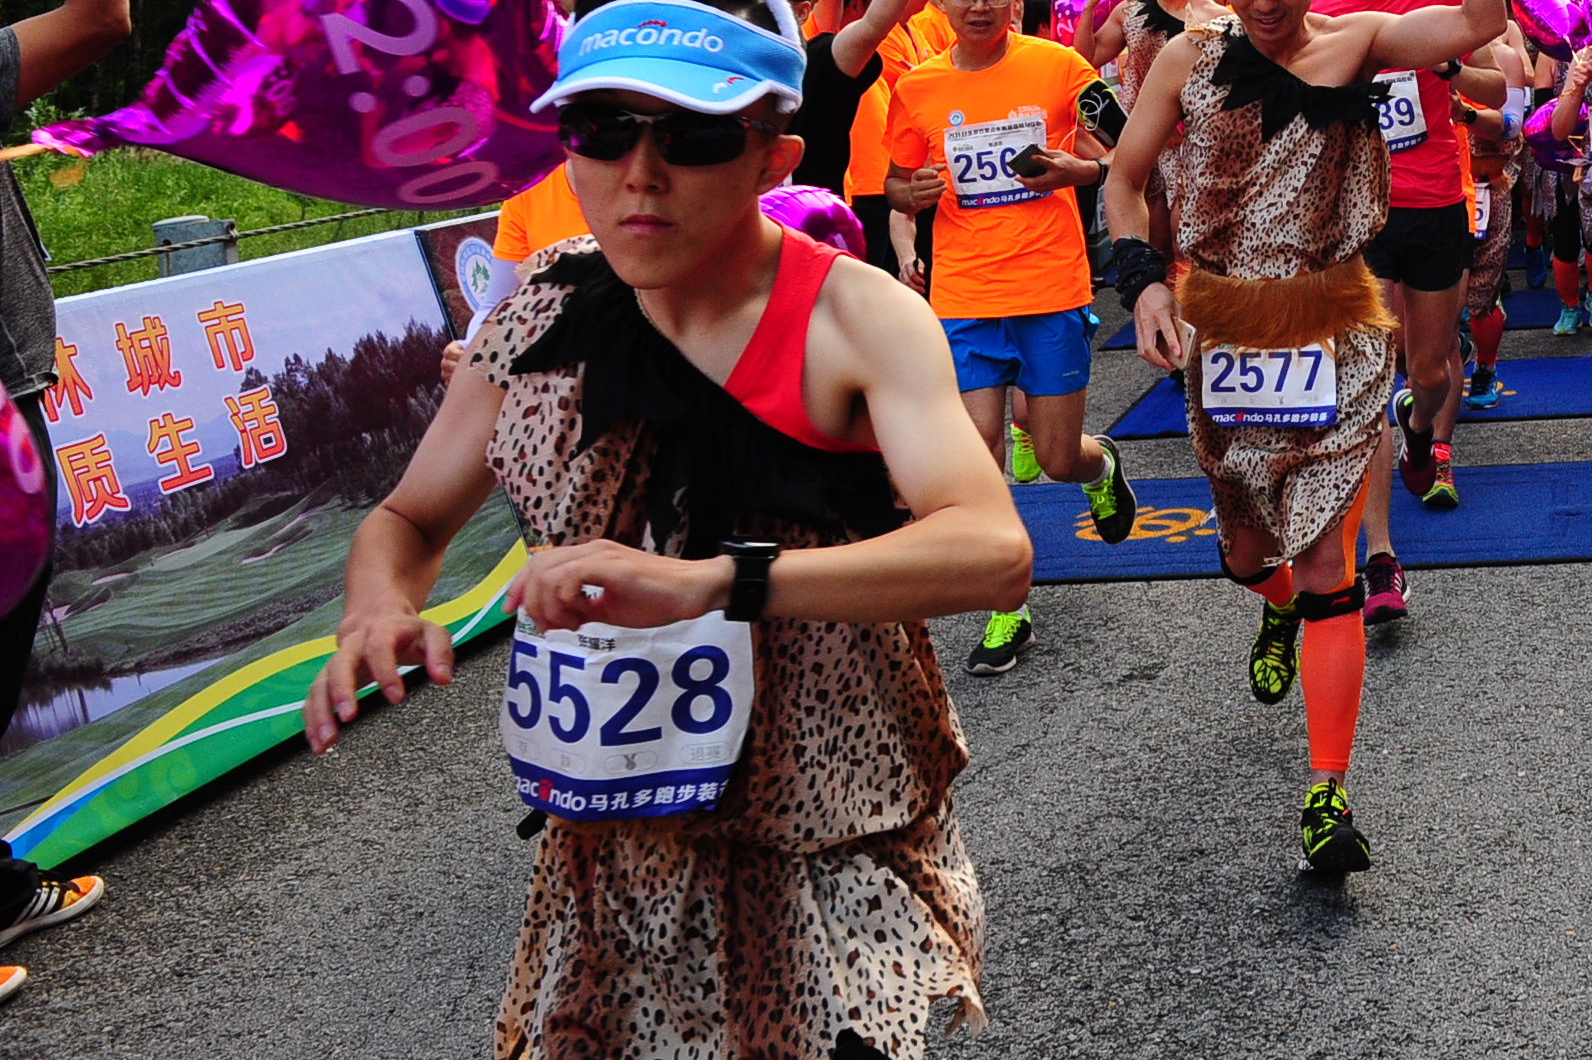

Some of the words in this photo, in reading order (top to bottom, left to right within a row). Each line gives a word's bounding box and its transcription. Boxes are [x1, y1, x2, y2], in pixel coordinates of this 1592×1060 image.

[577, 23, 725, 57] macondo
[1379, 97, 1416, 130] 39
[1210, 350, 1323, 393] 2577
[1212, 410, 1264, 423] macondo
[56, 386, 288, 529] 质生活
[507, 641, 733, 746] 5528
